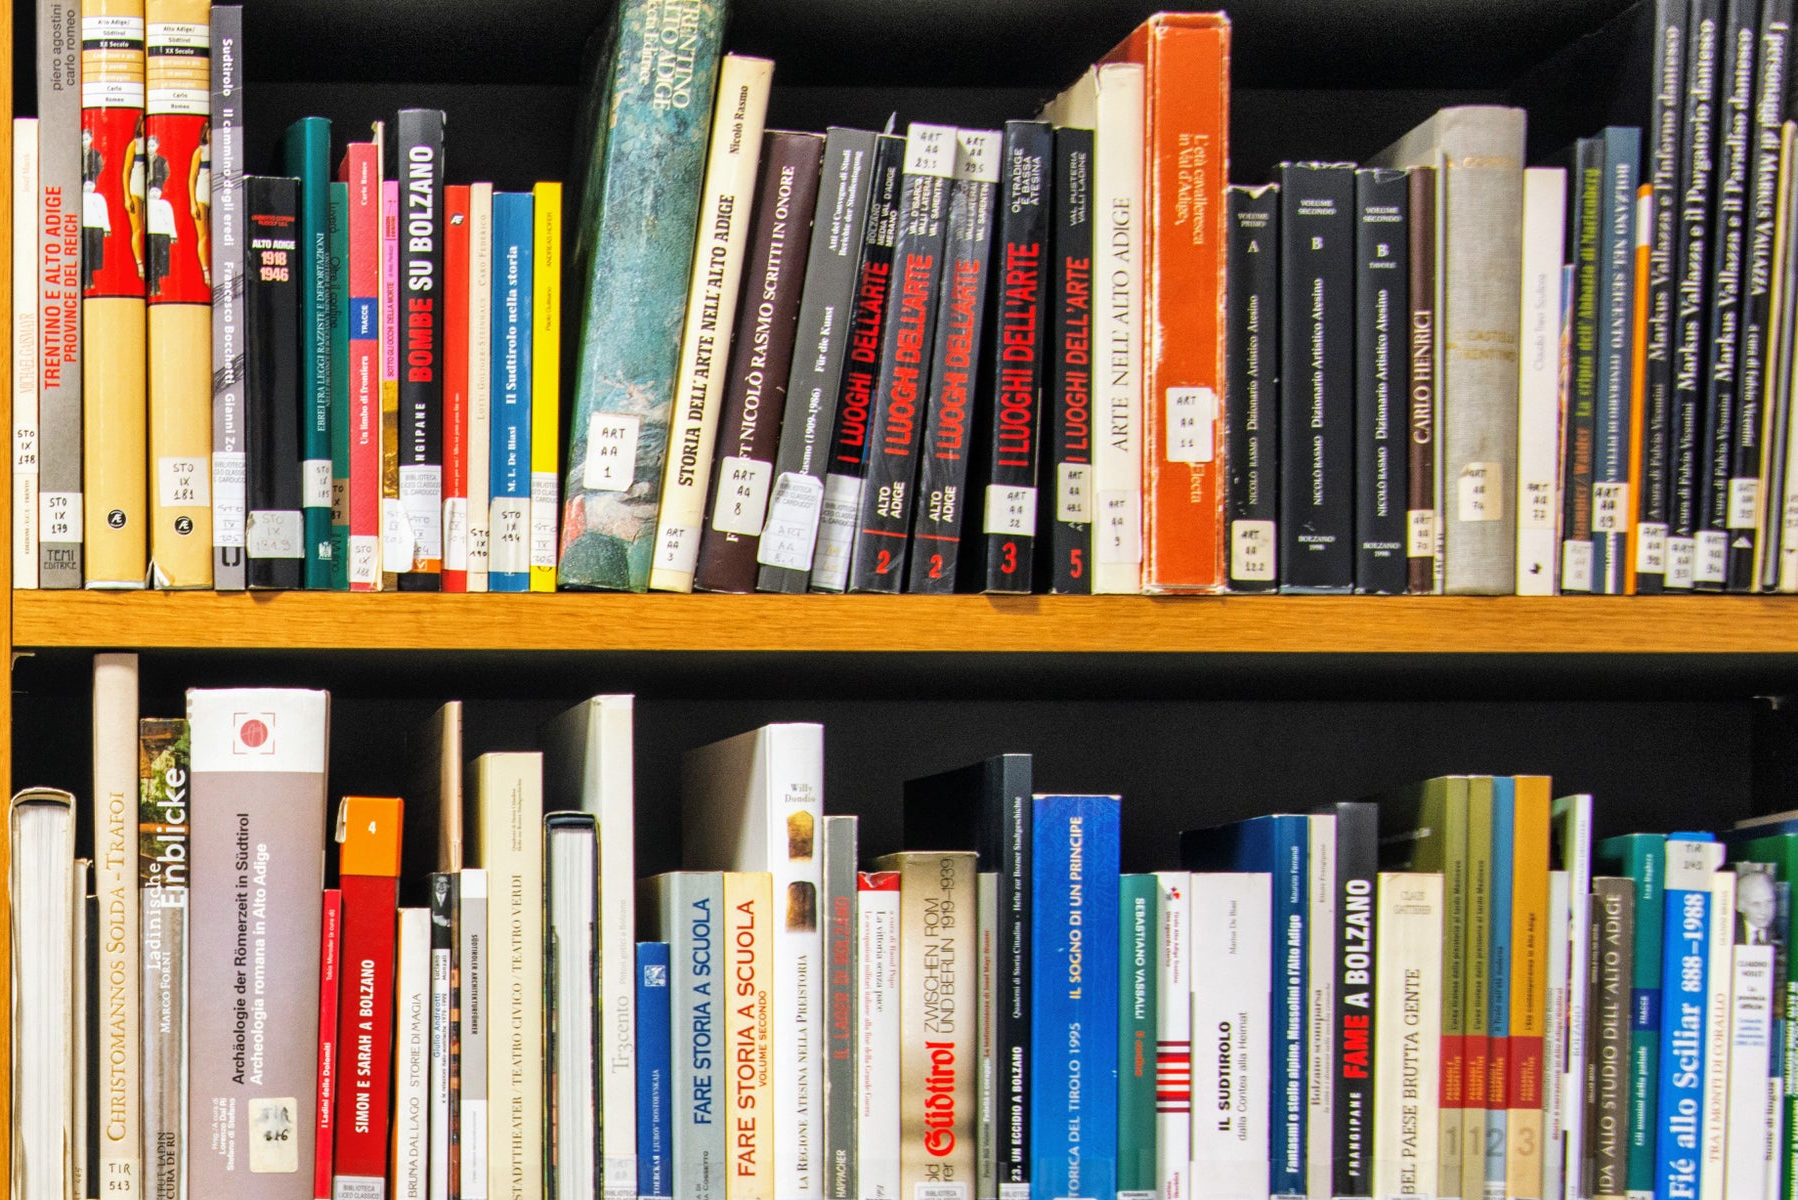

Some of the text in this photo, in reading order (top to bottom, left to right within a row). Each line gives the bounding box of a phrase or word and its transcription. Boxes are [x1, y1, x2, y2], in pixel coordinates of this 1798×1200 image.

[50, 3, 63, 90] piero agostini
[64, 9, 75, 85] carlo romeo
[729, 85, 748, 153] Nicolò Rasmo
[1112, 198, 1129, 262] ADIGE
[44, 186, 61, 389] TRENTINO E ALTO ADIGE
[63, 214, 77, 362] PROVINCE DEL REICH
[409, 146, 432, 383] BOMBE SU BOLZANO
[678, 427, 700, 486] STORIA
[714, 194, 734, 242] ADIGE
[1311, 278, 1322, 427] Dizionario Artistico Atesino
[359, 355, 368, 444] Un limbo di frontiera
[1413, 310, 1430, 443] CARLO HENRICI
[601, 446, 618, 456] AA
[602, 428, 626, 439] ART
[1111, 398, 1128, 451] ARTE
[50, 497, 67, 507] STO
[604, 466, 611, 478] 1
[51, 524, 68, 534] 179
[55, 511, 65, 520] IX
[44, 561, 76, 570] EDITRICE
[47, 550, 74, 561] TEMI
[159, 768, 188, 908] Einblicke
[105, 792, 125, 1142] CHRISTOMANNOS SOLDA TRAFOI
[231, 813, 249, 1084] Archäologie der Römerzeit in Südtirol
[1344, 880, 1370, 1077] FAME A BOLZANO
[359, 959, 374, 1016] BOLZANO
[692, 898, 711, 1124] FARE STORIA A SCUOLA
[357, 1035, 371, 1075] SARAH
[358, 1021, 372, 1030] A
[1672, 1003, 1699, 1087] Sciliar
[1218, 1021, 1230, 1130] IL SUDTIROLO
[355, 1092, 369, 1132] SIMON
[1669, 1099, 1696, 1148] allo
[1668, 1159, 1694, 1198] Fié
